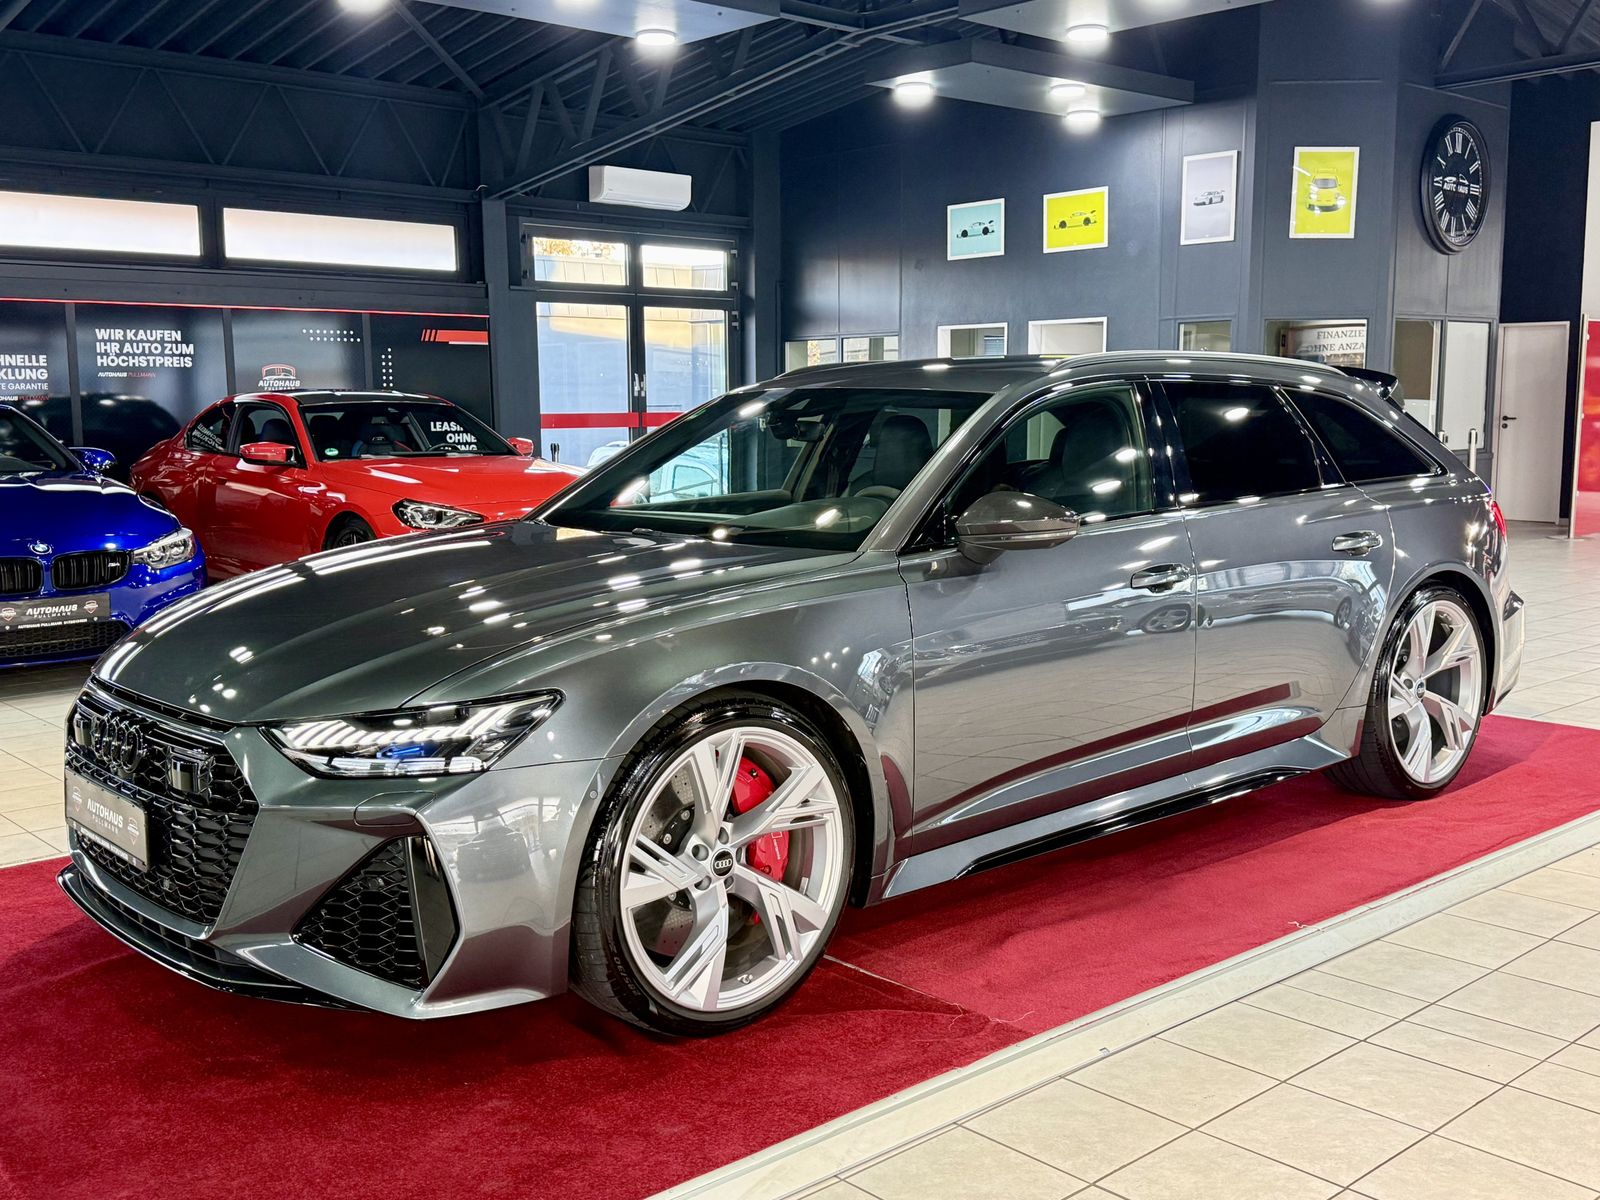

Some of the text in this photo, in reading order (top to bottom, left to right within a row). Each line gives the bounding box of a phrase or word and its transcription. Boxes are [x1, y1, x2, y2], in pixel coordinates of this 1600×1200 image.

[95, 328, 182, 341] WIR KAUFEN
[96, 342, 194, 355] IHR AUTO ZUM
[96, 353, 193, 368] HÖCHSTPREIS
[8, 382, 49, 390] GARANTIE
[446, 433, 477, 443] OHNE
[26, 604, 78, 616] AUTOHAUS
[87, 798, 124, 828] AUTOHAUS
